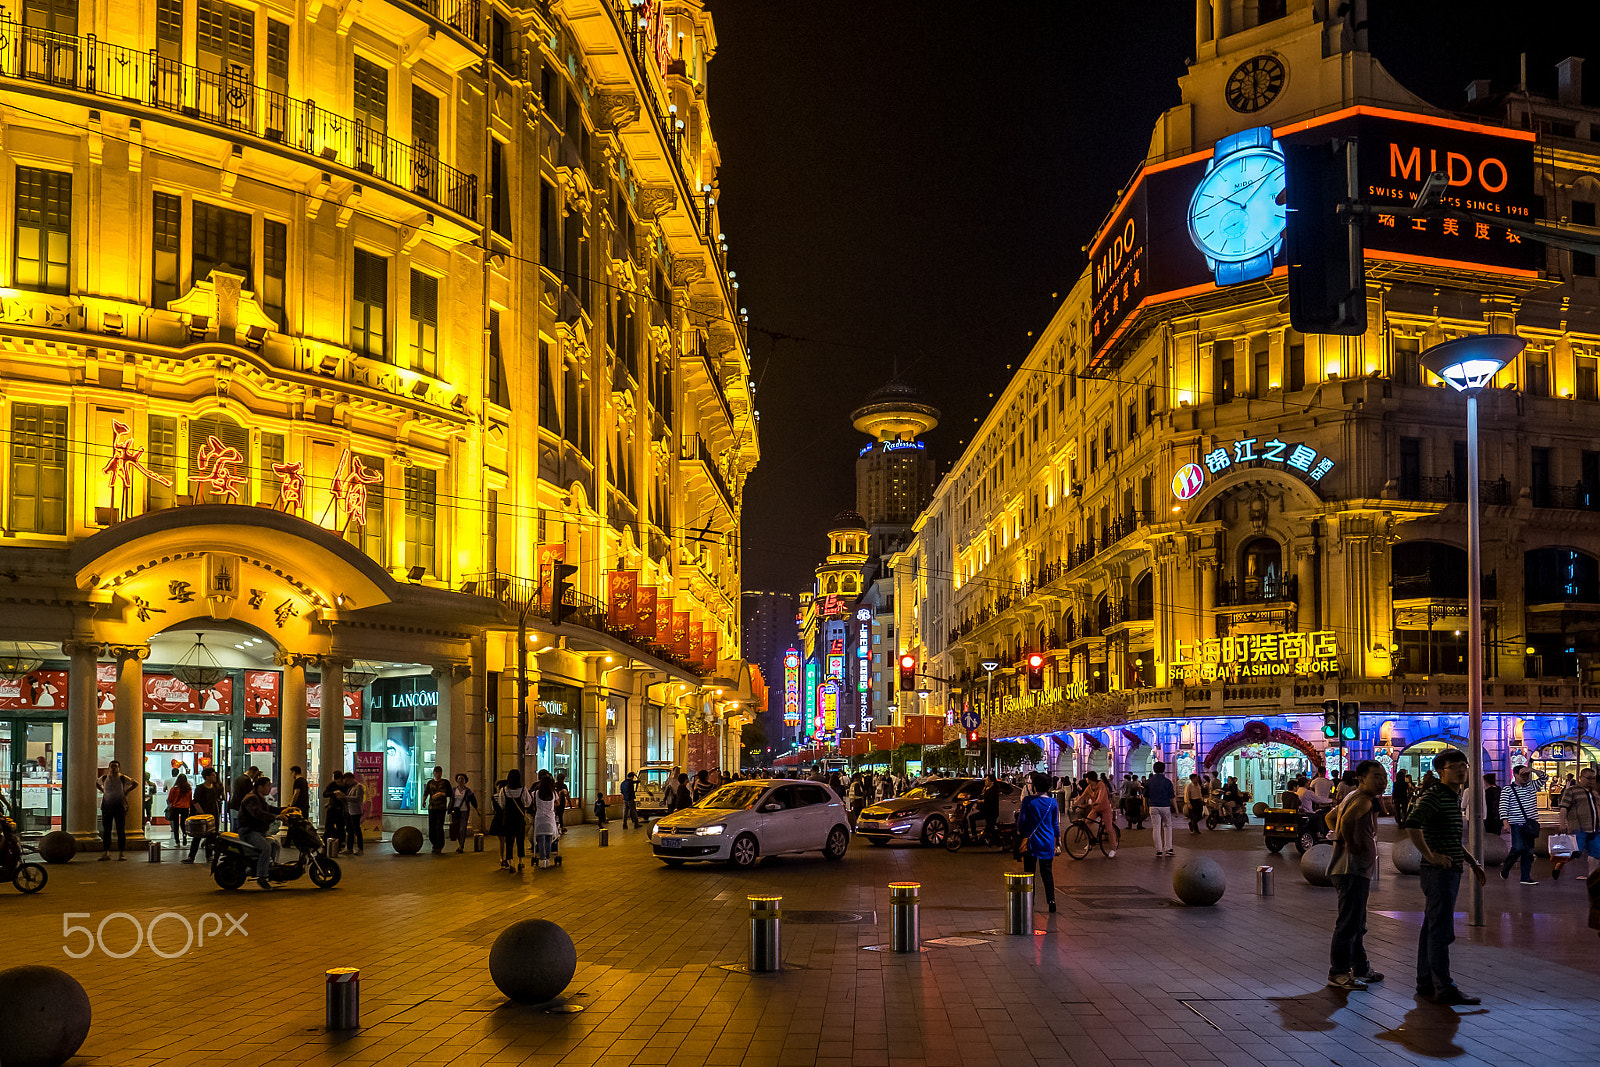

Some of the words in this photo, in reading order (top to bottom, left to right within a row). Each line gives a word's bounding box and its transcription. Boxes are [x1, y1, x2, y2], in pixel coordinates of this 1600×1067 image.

[1390, 143, 1508, 193] MIDO
[1369, 186, 1404, 199] SWISS
[1466, 200, 1501, 213] SINCE
[1507, 205, 1529, 216] 1918
[1097, 218, 1135, 293] MIDO
[1205, 438, 1317, 474] 锦江之星
[1169, 631, 1337, 665] 上海时装商店
[1169, 667, 1230, 680] SHANGHAI
[1235, 664, 1289, 676] FASHION
[1295, 660, 1338, 673] STORE
[1065, 680, 1089, 700] STORE
[357, 756, 381, 764] SALE
